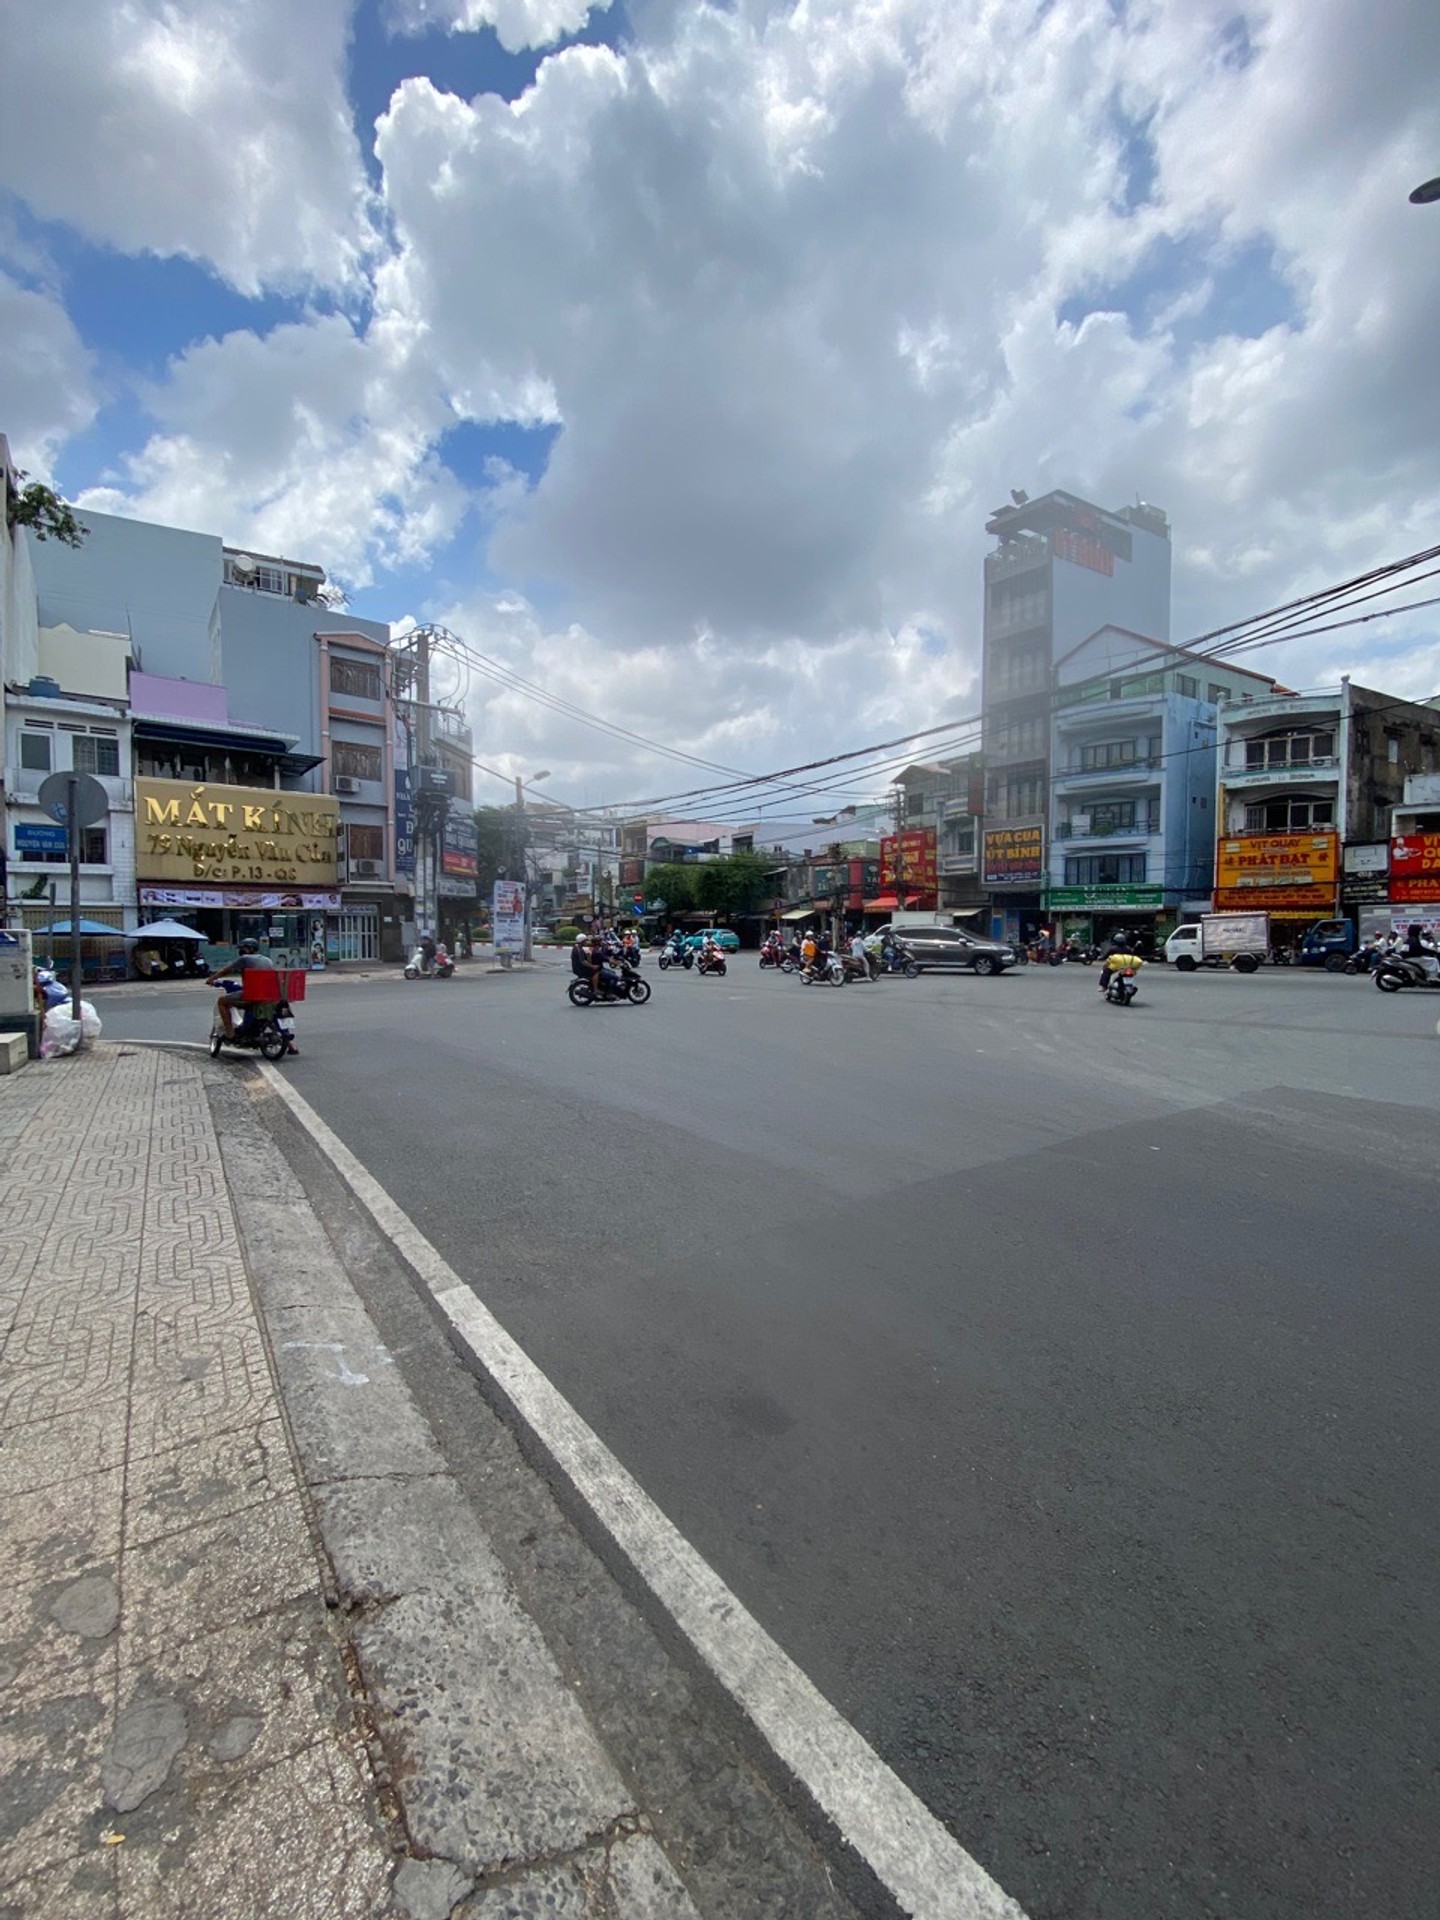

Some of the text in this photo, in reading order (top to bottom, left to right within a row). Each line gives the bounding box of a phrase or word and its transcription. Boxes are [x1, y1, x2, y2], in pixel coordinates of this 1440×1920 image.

[144, 786, 336, 838] MẮT KÍNH
[1014, 829, 1041, 843] CUA
[1271, 838, 1302, 848] QUAY
[147, 833, 172, 855] 79
[175, 833, 250, 863] Nguyễn
